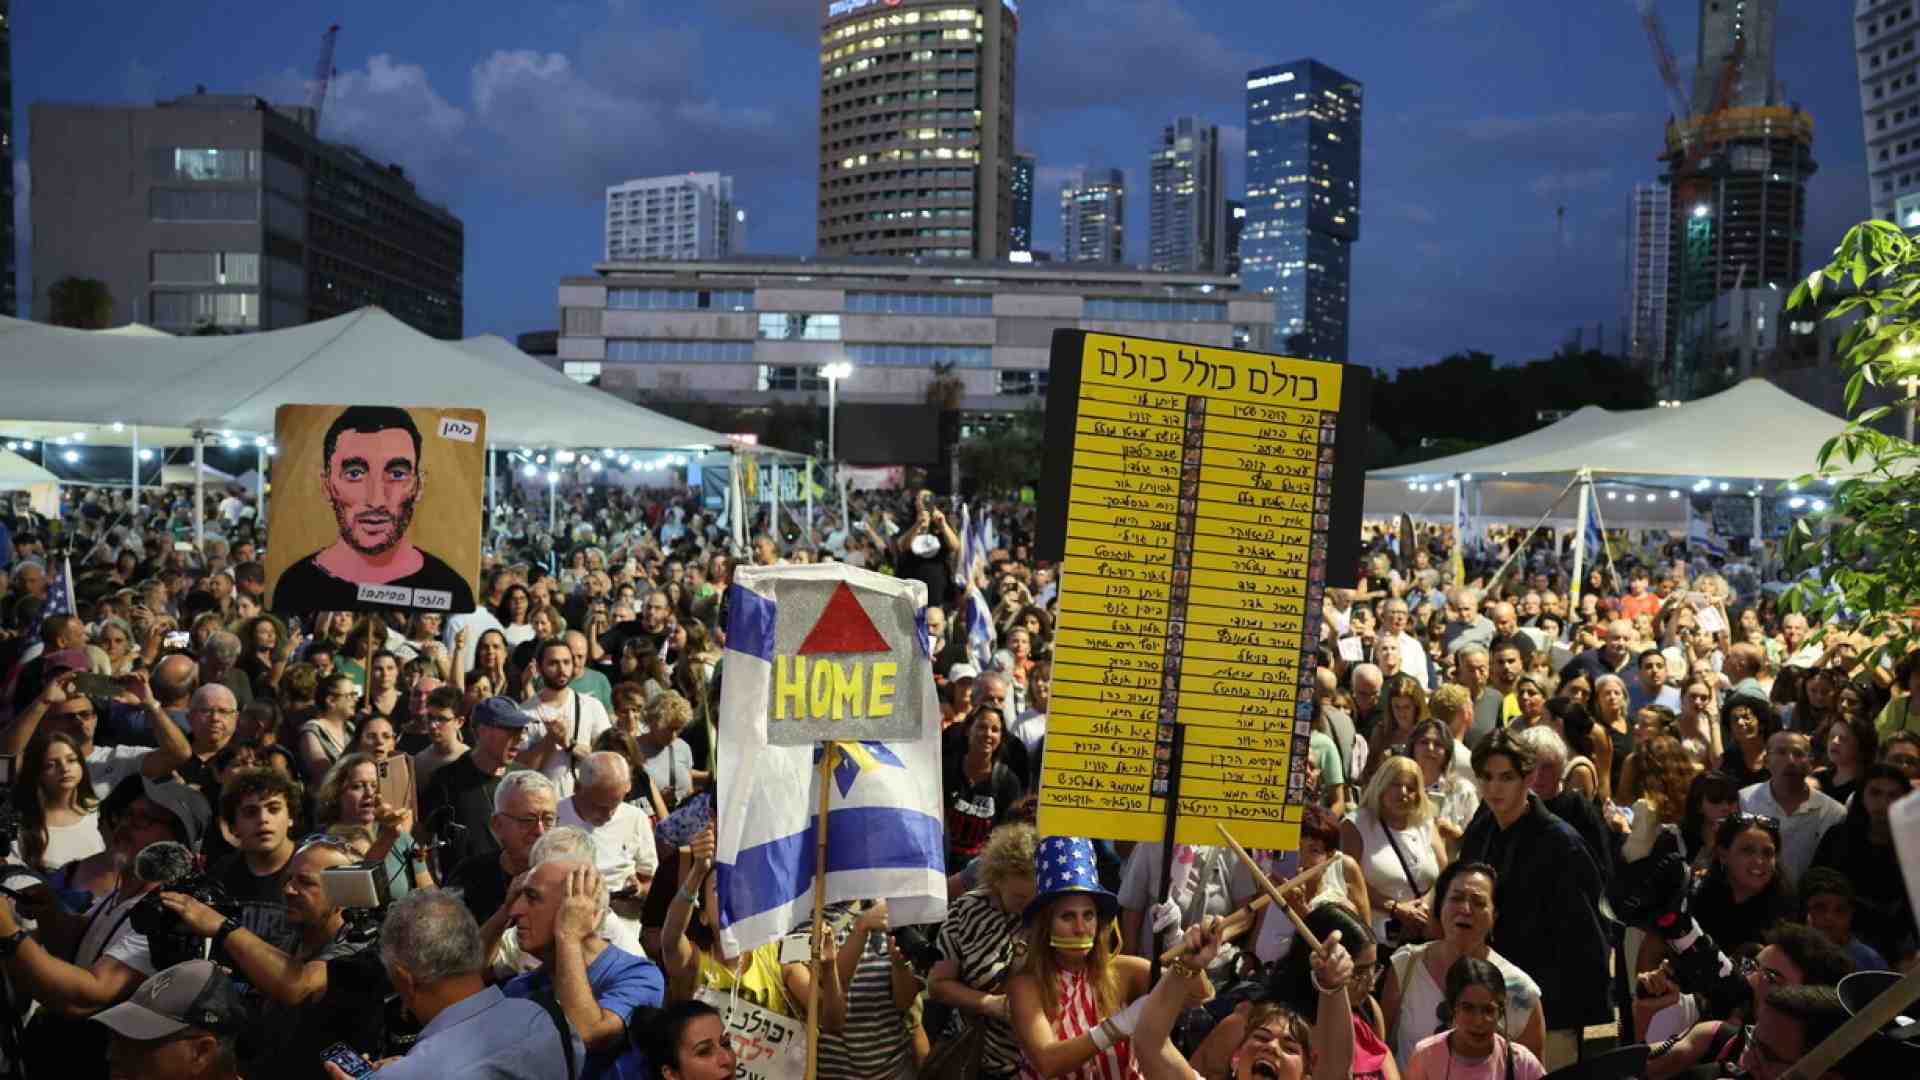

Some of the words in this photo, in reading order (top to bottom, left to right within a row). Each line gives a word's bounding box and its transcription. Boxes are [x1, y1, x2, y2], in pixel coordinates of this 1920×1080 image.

[1096, 339, 1168, 382] כולם
[1175, 348, 1237, 390] כולל
[1246, 358, 1319, 401] כולם
[443, 422, 472, 436] מתן
[774, 655, 898, 720] HOME
